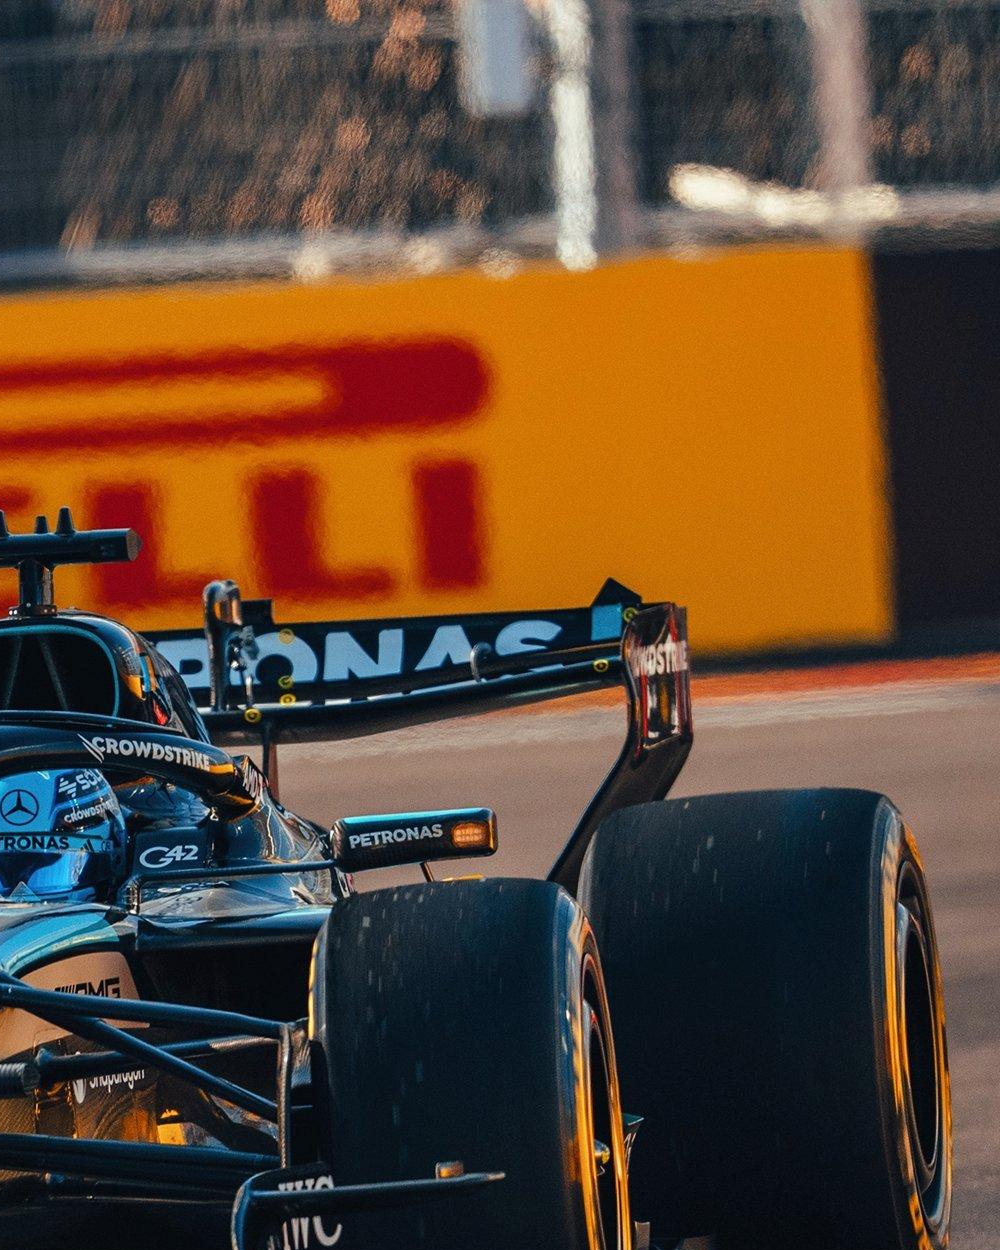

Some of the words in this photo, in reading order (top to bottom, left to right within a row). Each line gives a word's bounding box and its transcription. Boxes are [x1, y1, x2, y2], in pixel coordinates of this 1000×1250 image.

[91, 736, 210, 773] CROWDSTRIKE
[349, 823, 444, 849] PETRONAS
[139, 845, 199, 869] G42
